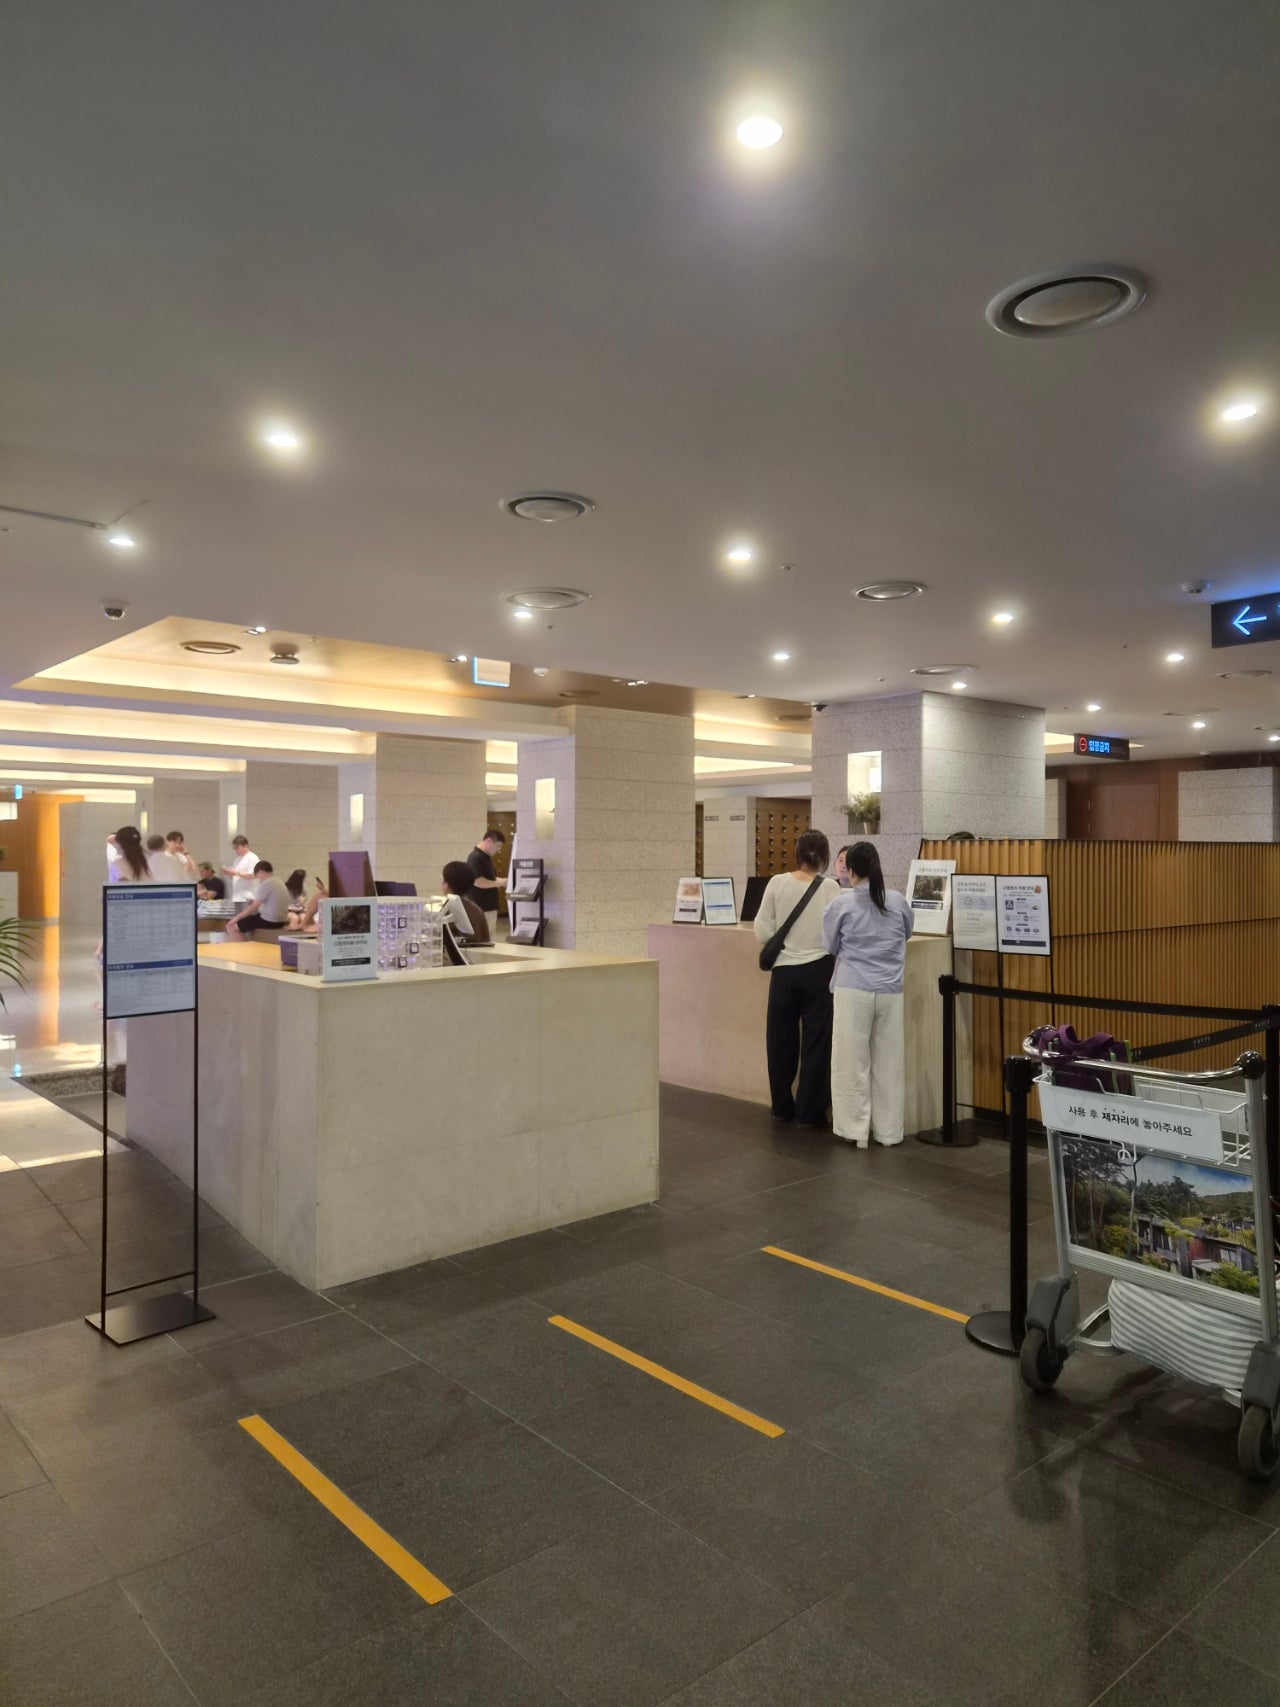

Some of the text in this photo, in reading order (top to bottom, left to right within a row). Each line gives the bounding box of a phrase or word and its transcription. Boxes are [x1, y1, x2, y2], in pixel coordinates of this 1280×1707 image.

[1088, 740, 1109, 753] 입장금지
[1068, 1105, 1193, 1137] 사용 후 제자리에 놓아주세요
